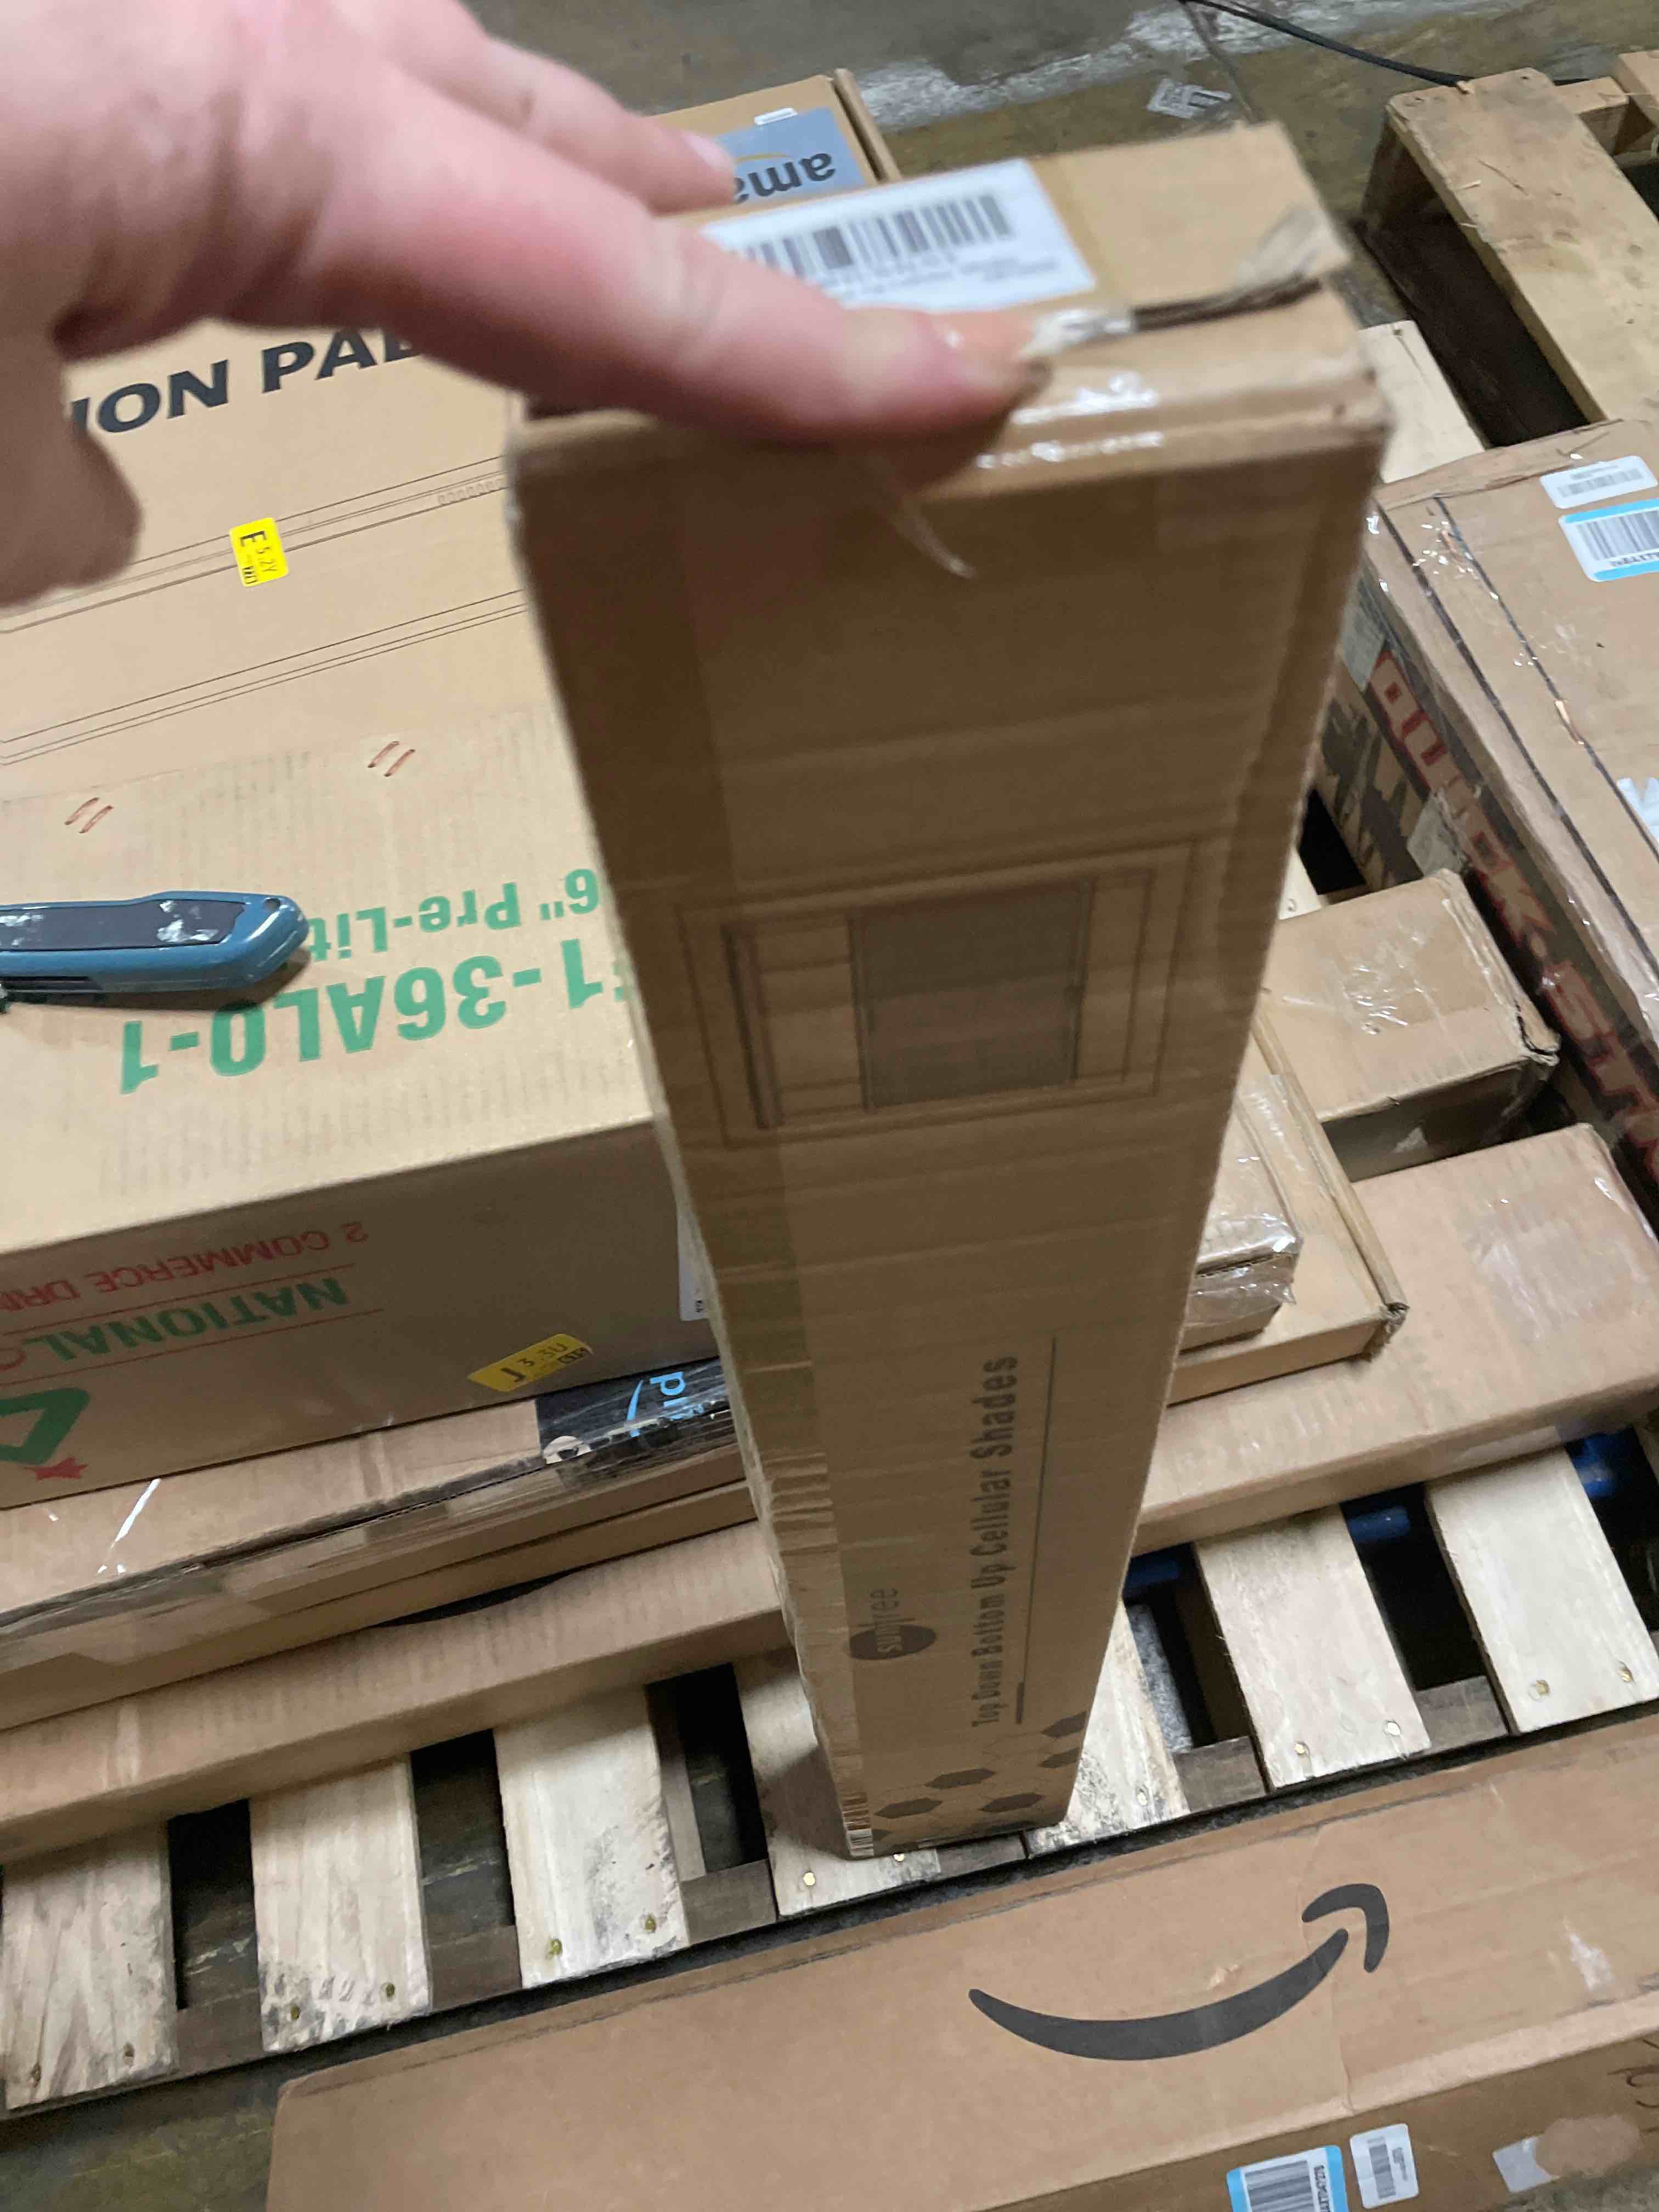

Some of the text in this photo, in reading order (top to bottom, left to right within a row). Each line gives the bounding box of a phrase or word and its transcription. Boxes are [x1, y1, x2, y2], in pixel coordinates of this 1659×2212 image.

[94, 1233, 330, 1294] COMMERCE
[341, 1222, 369, 1243] 2
[26, 1276, 350, 1362] NATIONAL
[967, 1355, 1019, 1728] Top Down Bottom Up Cellular Shades
